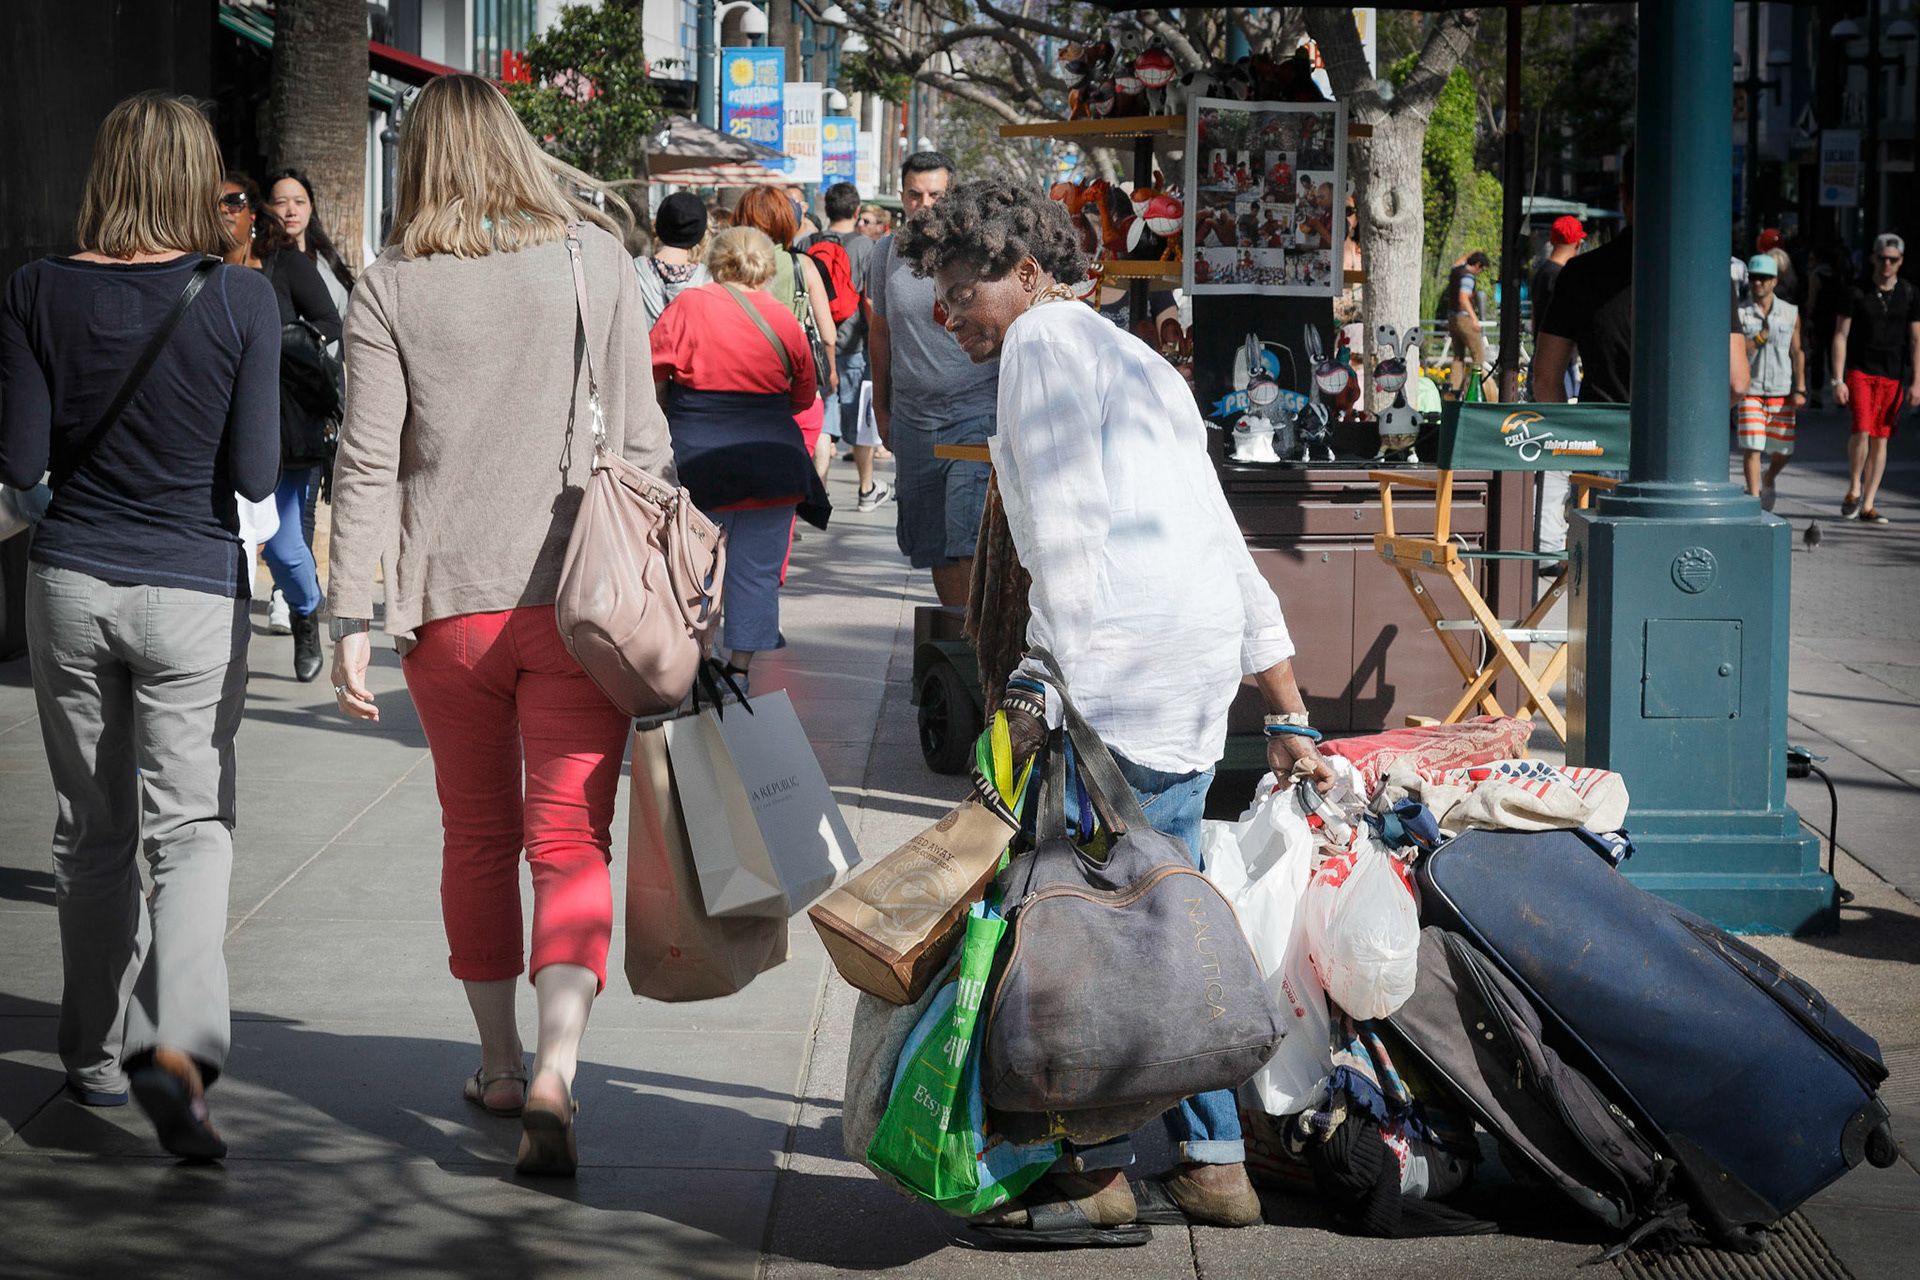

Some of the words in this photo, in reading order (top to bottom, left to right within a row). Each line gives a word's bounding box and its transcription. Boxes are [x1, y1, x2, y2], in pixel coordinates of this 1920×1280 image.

[729, 118, 752, 139] 25
[823, 160, 838, 176] 25
[1543, 439, 1568, 450] third
[759, 775, 800, 799] REPUBLIC
[928, 843, 955, 861] AWAY
[1183, 897, 1227, 1024] NAUTICA
[912, 1084, 940, 1117] Etsy
